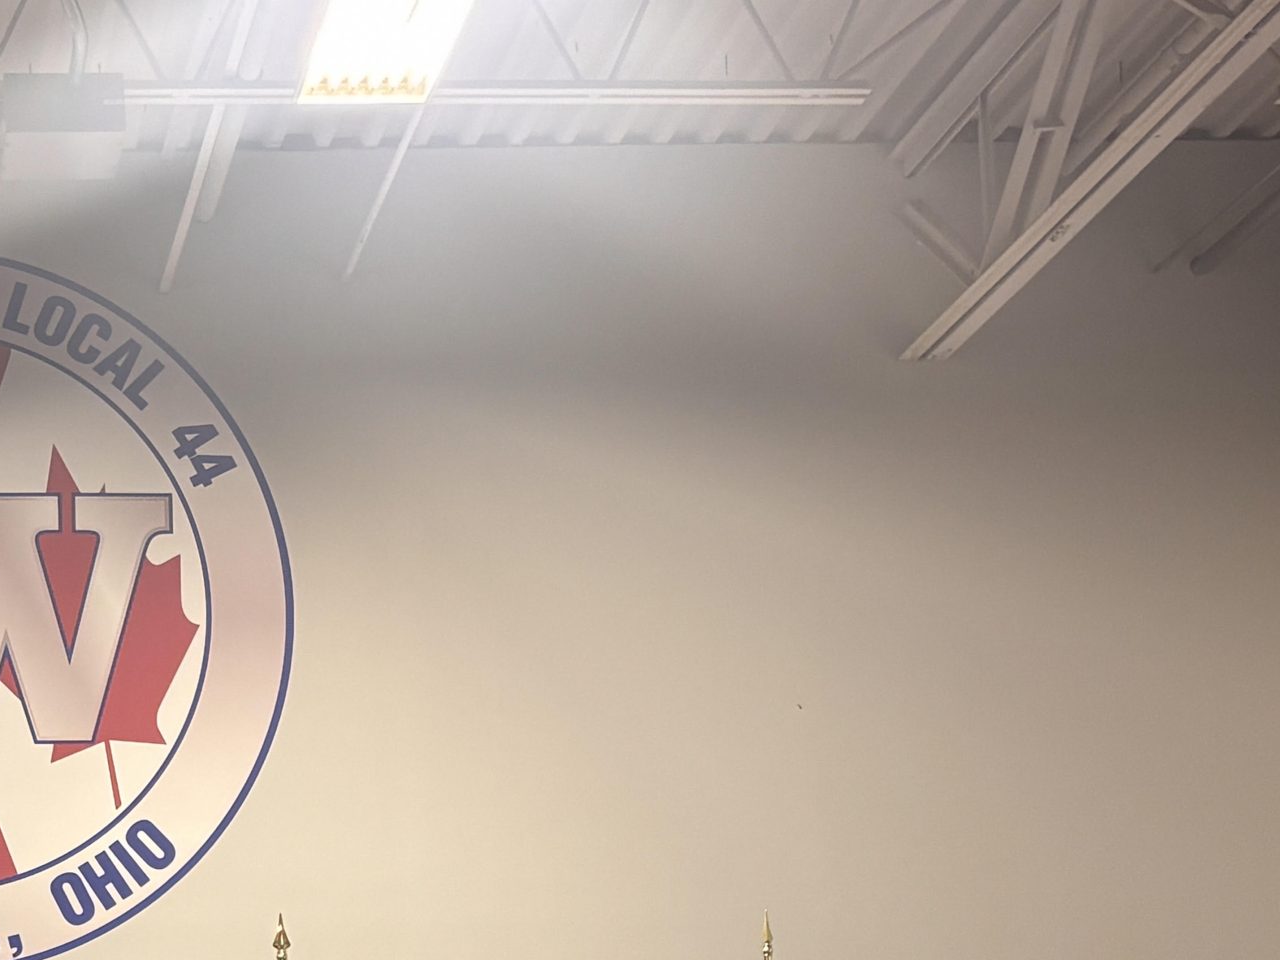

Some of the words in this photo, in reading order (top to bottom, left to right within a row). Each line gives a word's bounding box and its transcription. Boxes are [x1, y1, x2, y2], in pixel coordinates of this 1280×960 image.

[3, 281, 166, 411] LOCAL
[171, 423, 237, 488] 44
[49, 818, 177, 927] OHIO
